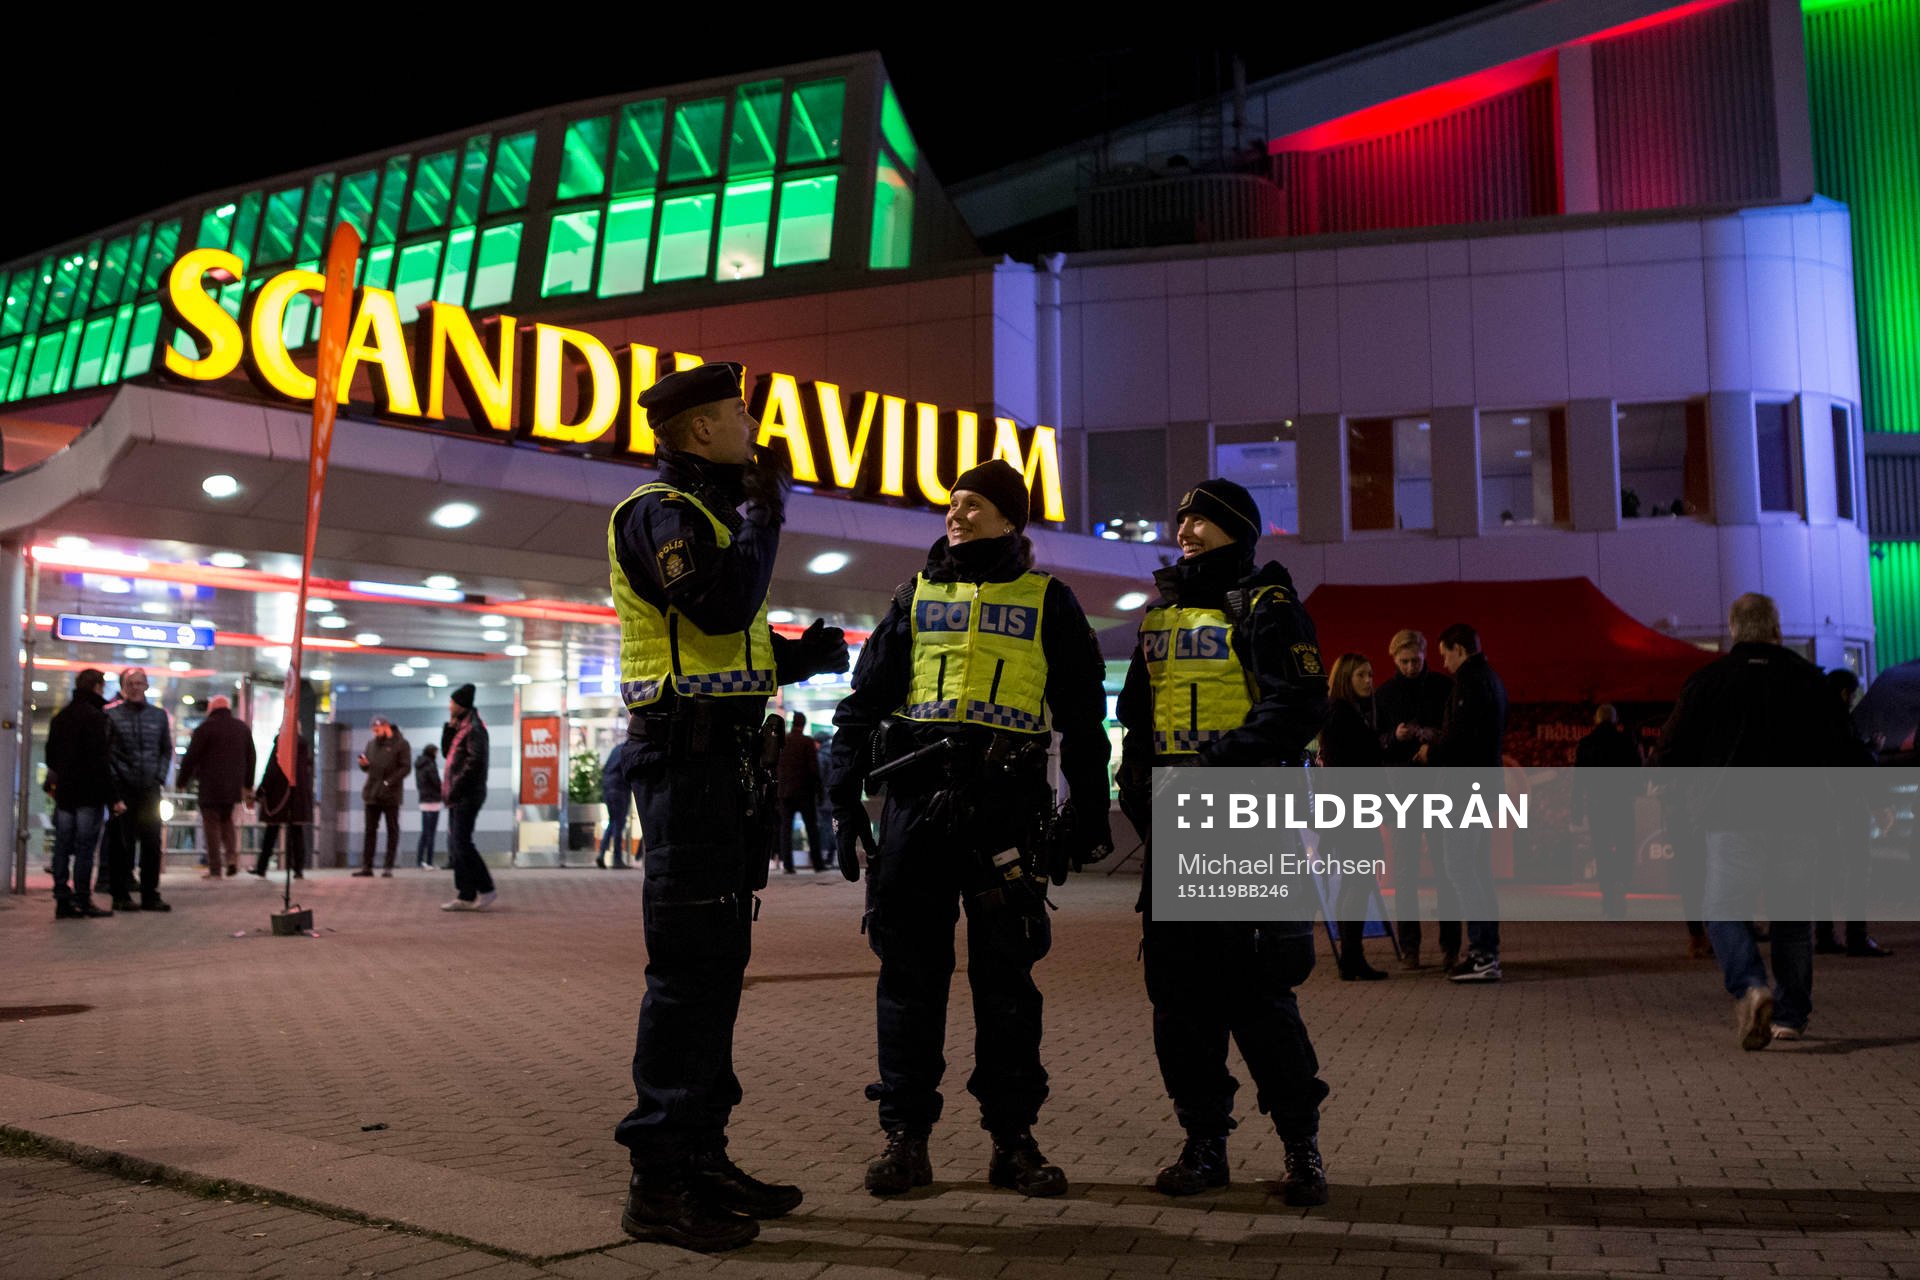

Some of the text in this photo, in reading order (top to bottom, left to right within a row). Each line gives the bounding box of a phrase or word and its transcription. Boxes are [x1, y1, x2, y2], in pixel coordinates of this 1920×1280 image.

[165, 249, 1065, 522] SCANDIAVIUM
[658, 540, 684, 560] POLIS
[925, 602, 1027, 636] POLIS
[1143, 629, 1219, 662] POLIS
